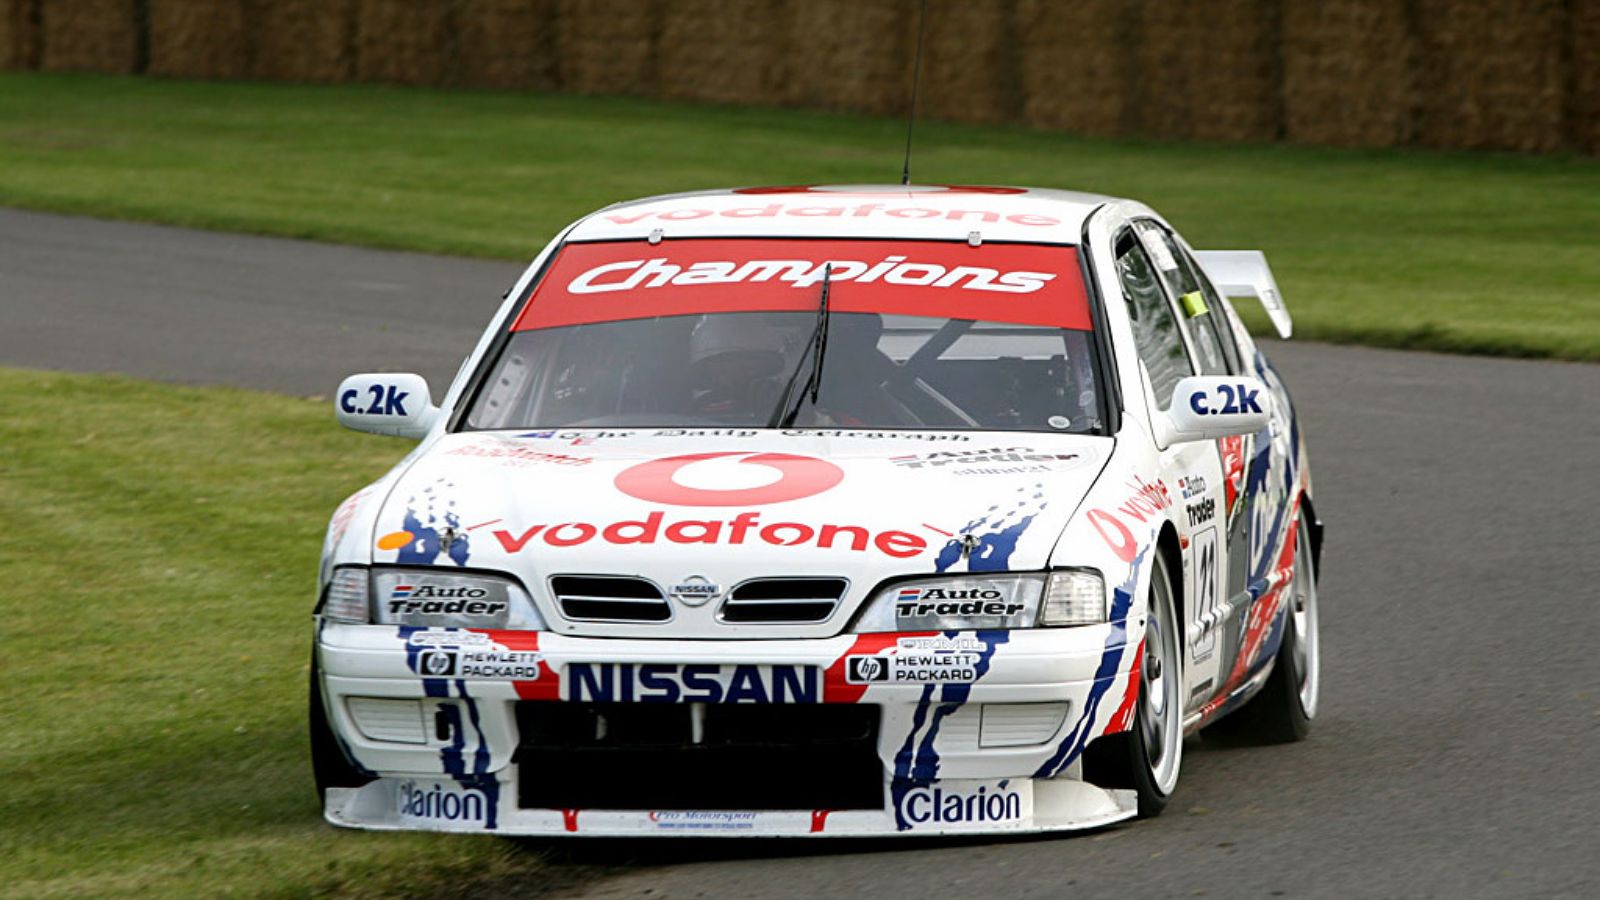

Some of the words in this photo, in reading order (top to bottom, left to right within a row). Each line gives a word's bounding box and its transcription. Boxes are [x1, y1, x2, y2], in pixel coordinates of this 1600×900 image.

[605, 203, 1061, 226] vodafone
[567, 255, 1057, 294] Champions
[340, 384, 410, 416] c.2k
[1189, 384, 1263, 415] c.2k
[1186, 497, 1215, 527] Trader
[492, 511, 928, 558] vodafone
[413, 585, 486, 598] Auto
[674, 585, 717, 594] NISSAN
[922, 588, 1001, 600] Auto
[388, 600, 505, 615] Trader
[896, 602, 1024, 616] Trader
[463, 651, 537, 663] HEWLETT
[895, 655, 972, 666] HEWLETT
[462, 665, 536, 678] PACKARD
[860, 657, 878, 680] hp
[895, 669, 973, 681] PACKARD
[568, 663, 818, 705] NISSAN
[906, 785, 1020, 823] Clarion
[684, 810, 757, 822] Motorsport
